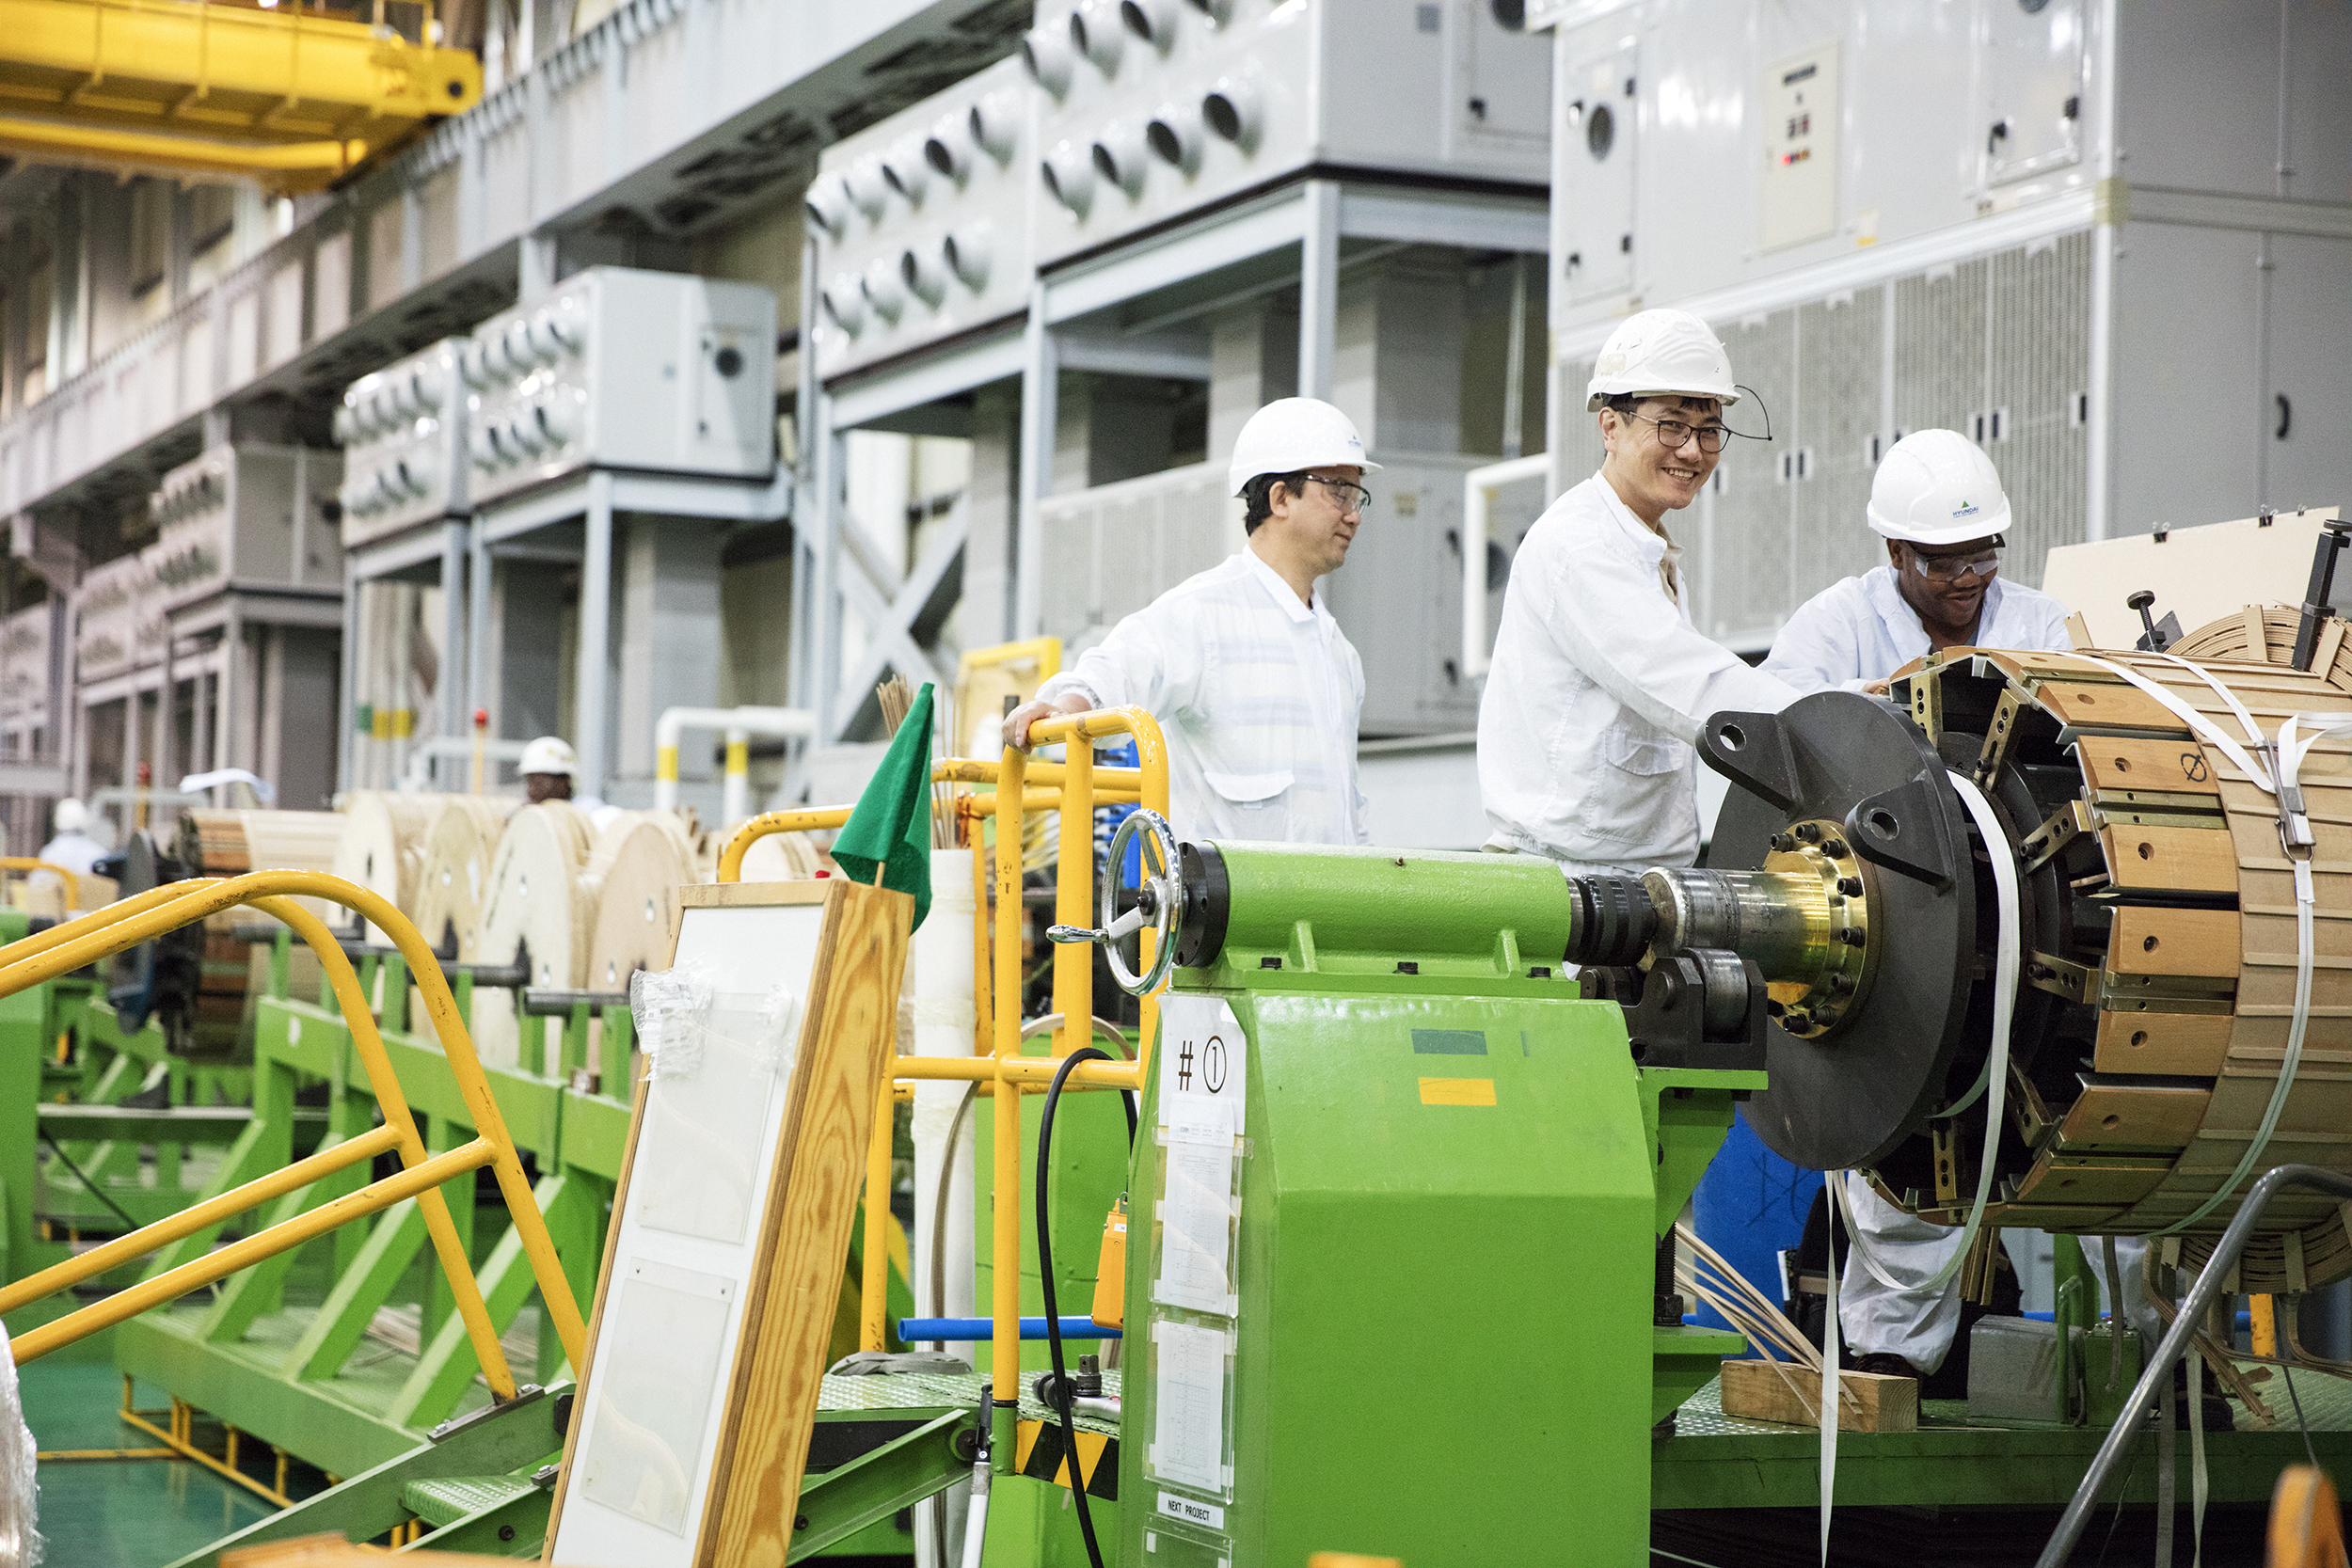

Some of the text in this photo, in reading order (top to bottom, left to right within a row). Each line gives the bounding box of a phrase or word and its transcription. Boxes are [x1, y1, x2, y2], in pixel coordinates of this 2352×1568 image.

[1952, 506, 1979, 516] HYUNDAI
[1168, 1499, 1210, 1521] NEXT PROJECT
